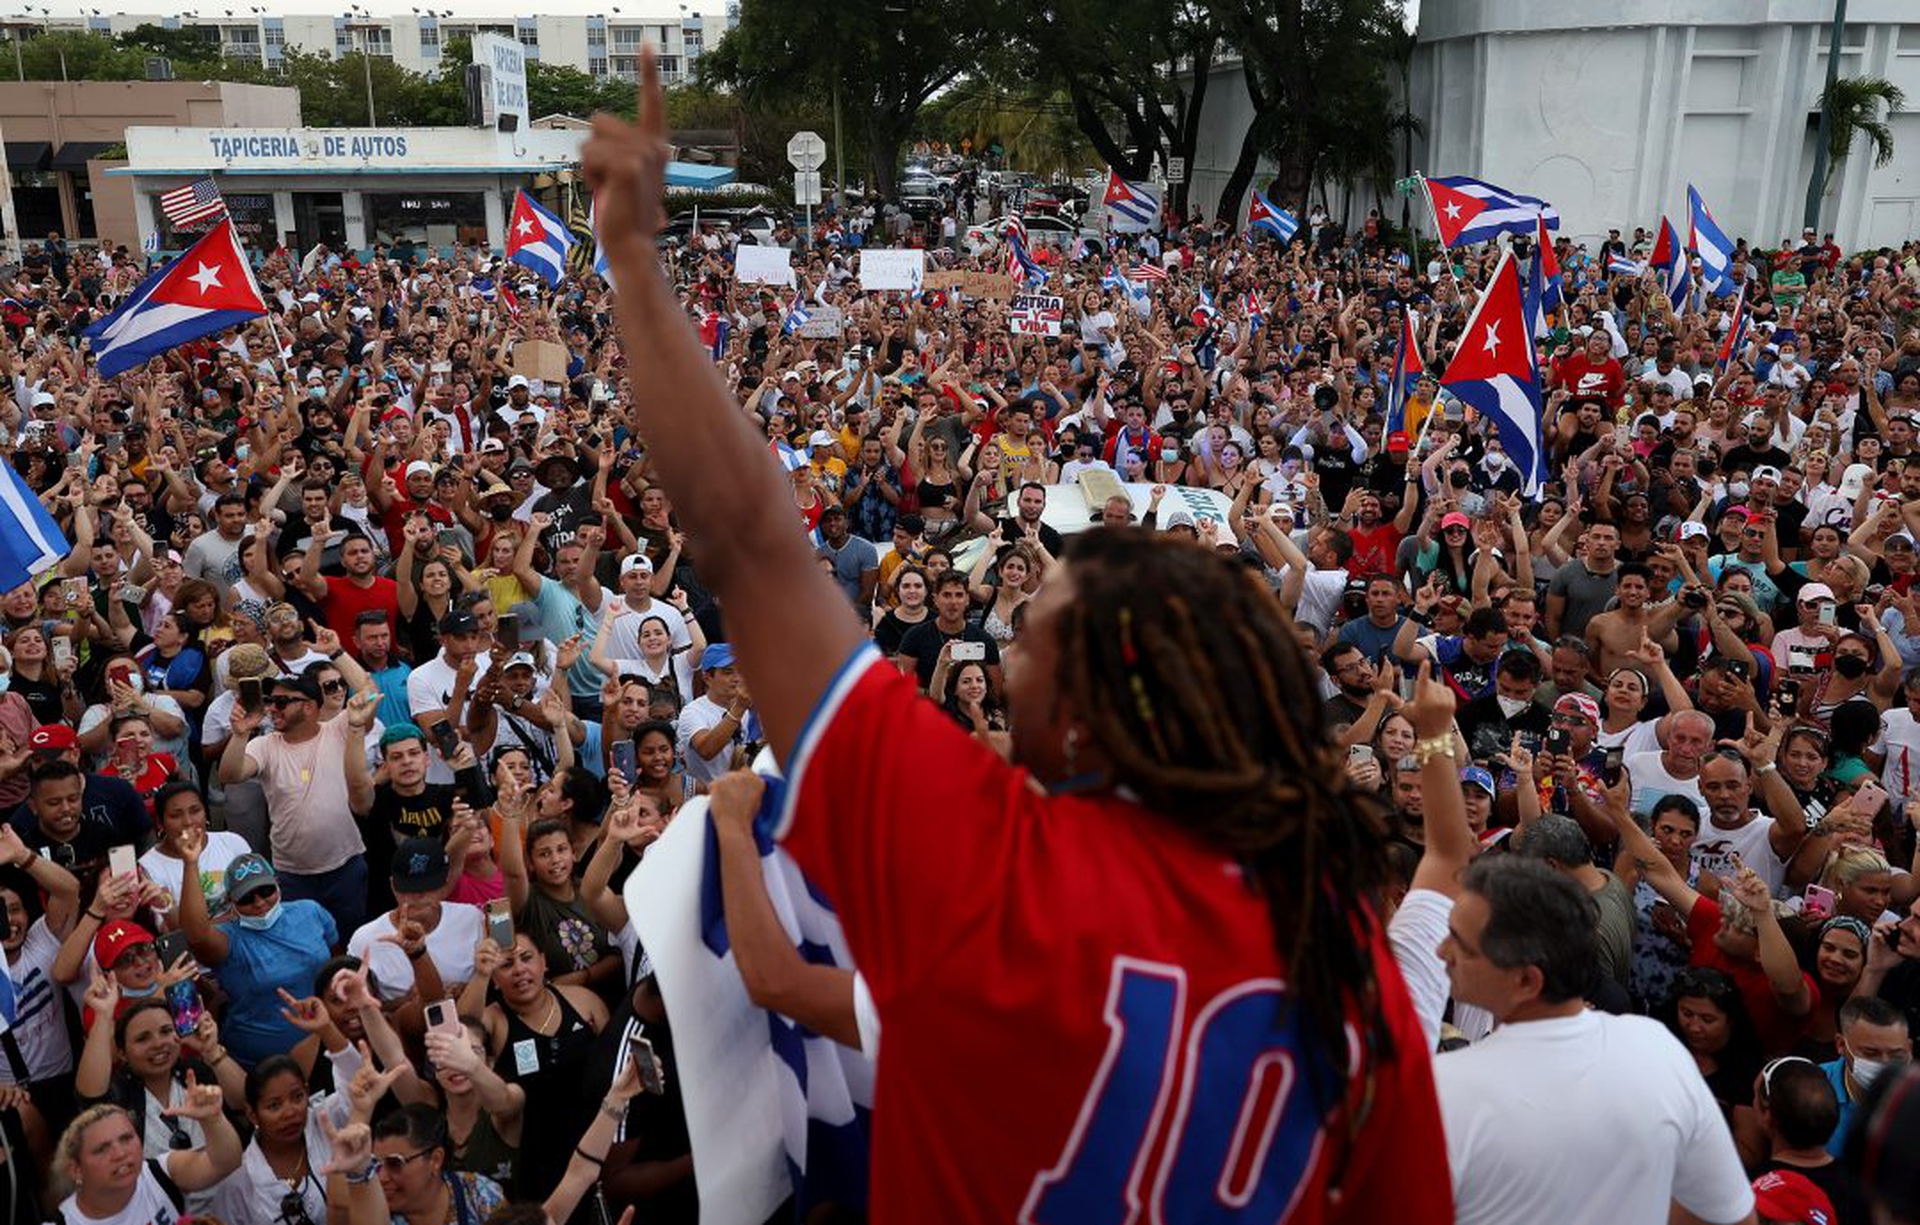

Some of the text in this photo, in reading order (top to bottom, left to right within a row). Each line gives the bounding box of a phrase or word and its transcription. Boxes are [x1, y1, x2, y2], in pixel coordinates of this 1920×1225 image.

[210, 136, 407, 158] TAPICERIA DE AUTOS
[1014, 294, 1060, 310] PATRIA
[1032, 309, 1041, 322] Y
[1018, 320, 1050, 335] VIDA
[33, 731, 50, 744] C
[1018, 955, 1361, 1225] 10
